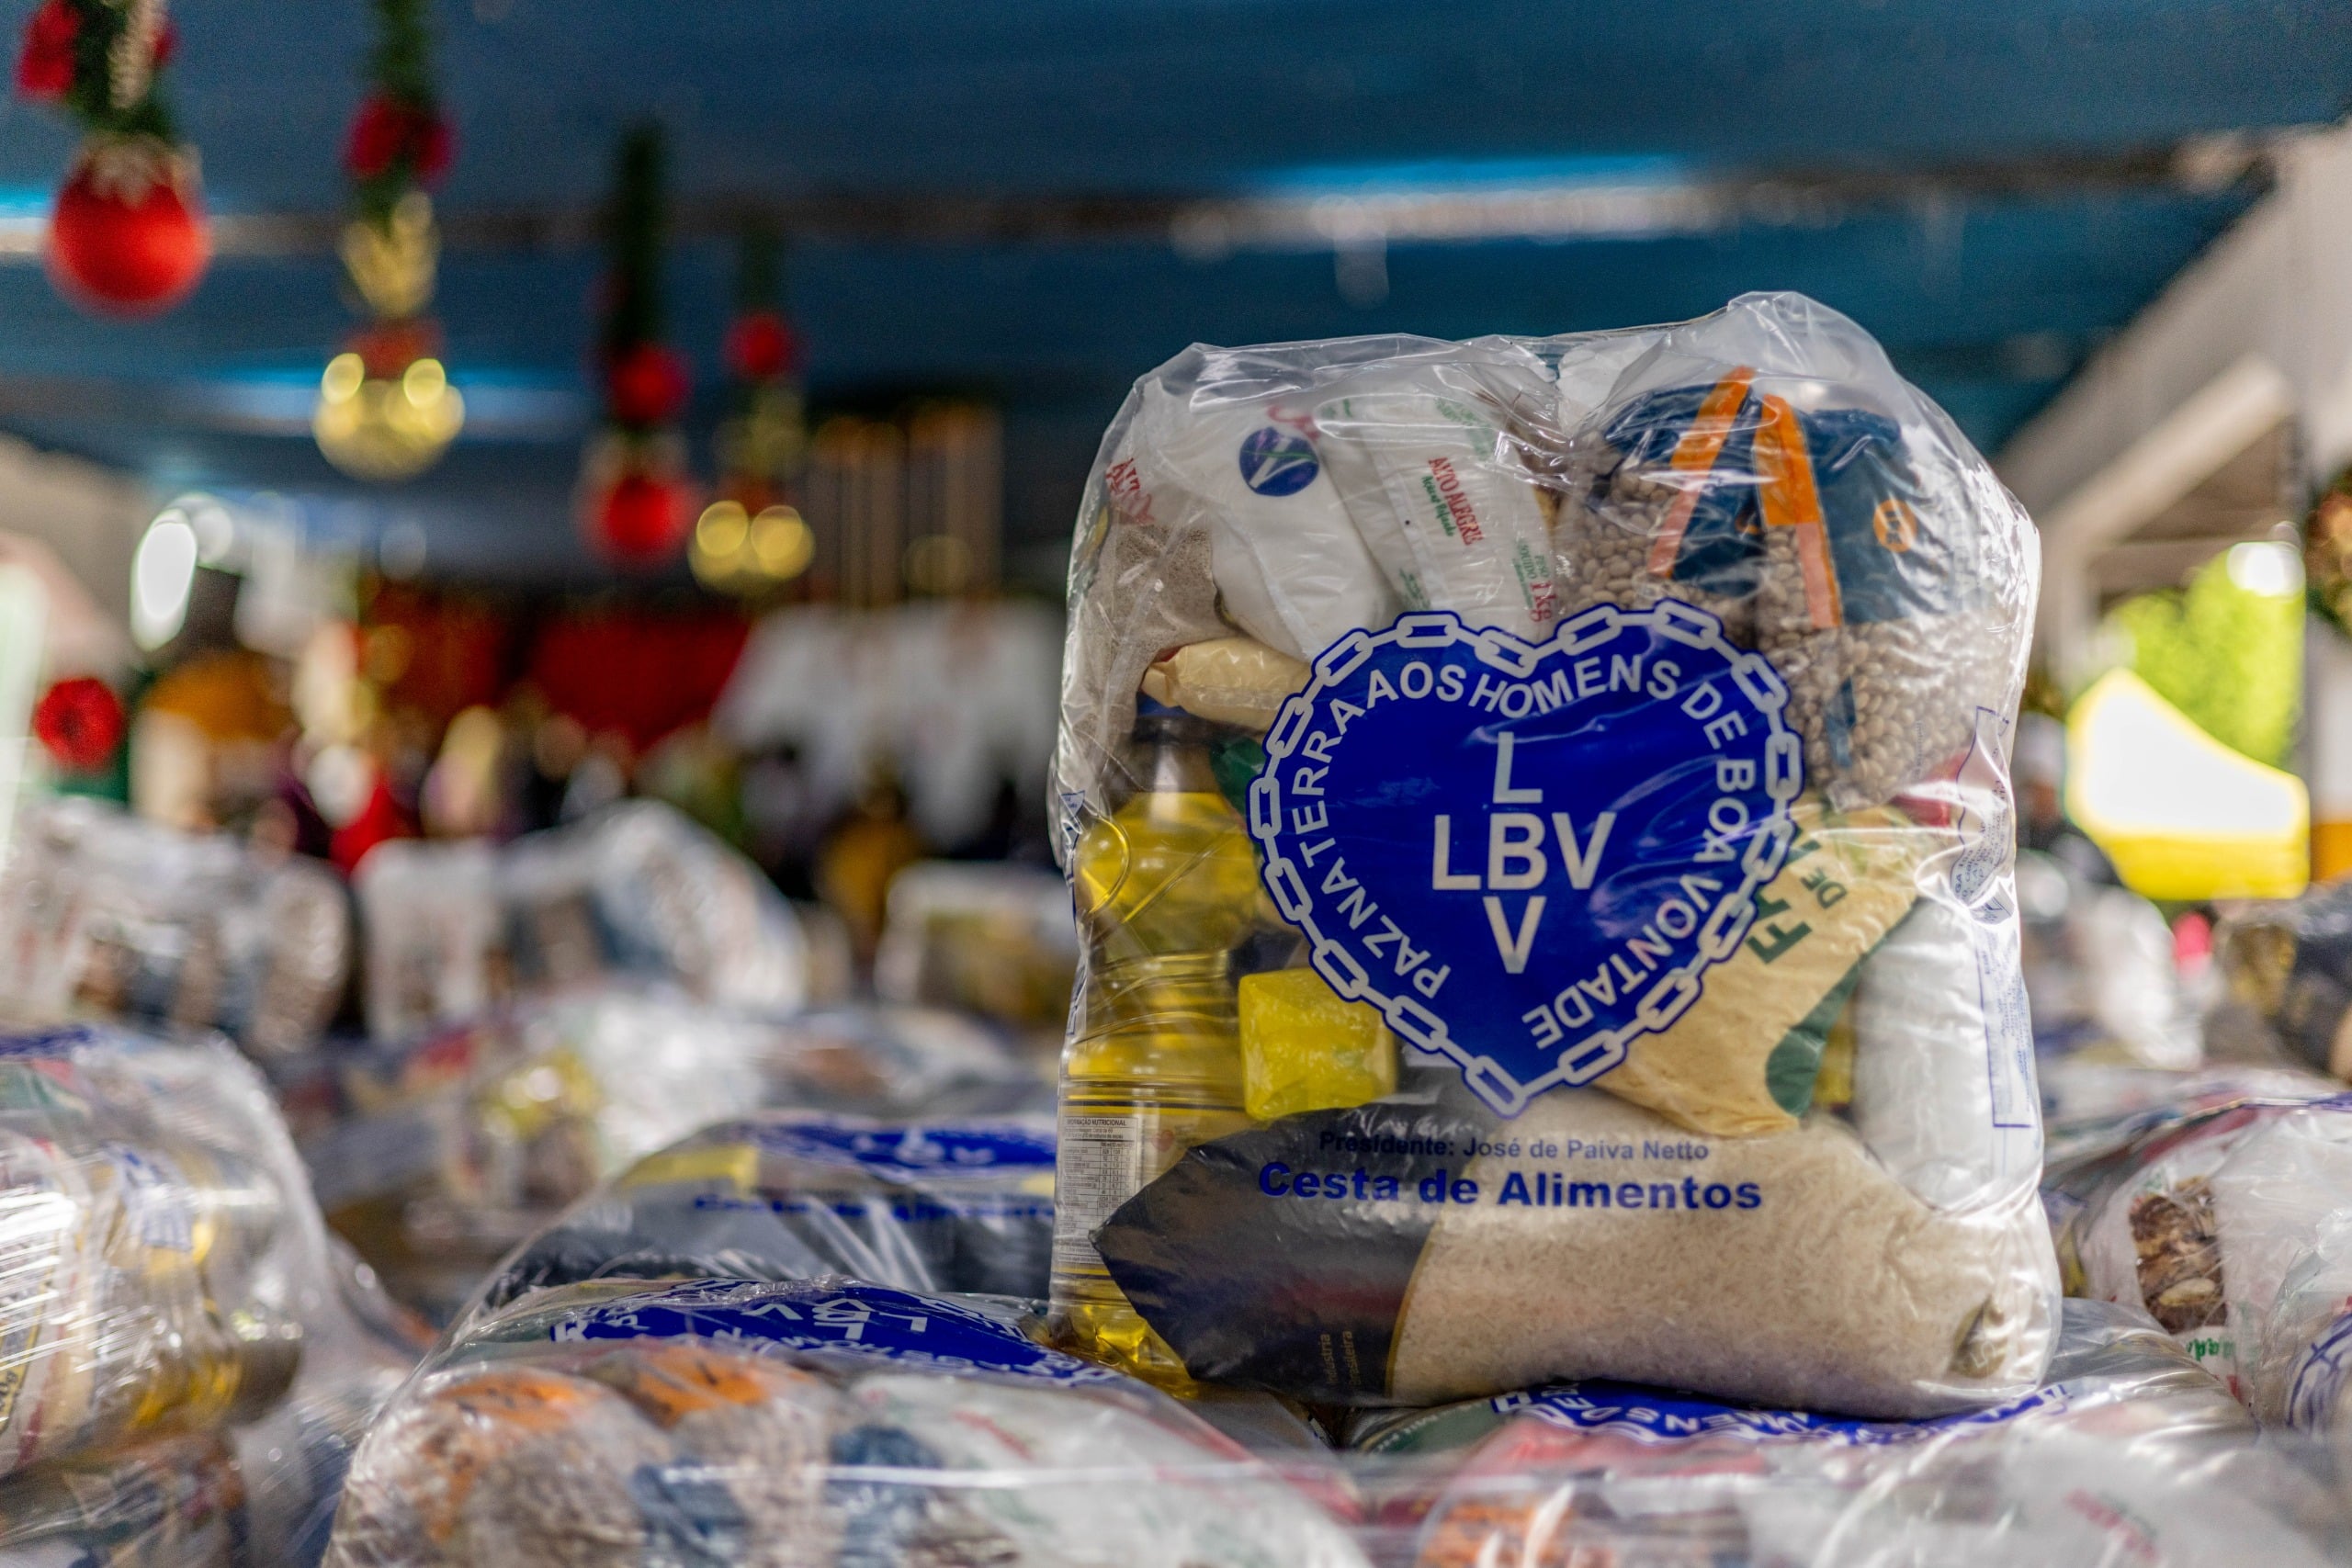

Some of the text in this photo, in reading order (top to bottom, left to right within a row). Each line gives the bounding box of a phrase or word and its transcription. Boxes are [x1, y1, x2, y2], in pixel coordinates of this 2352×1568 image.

[1443, 491, 1485, 546] ALEGRE
[1367, 660, 1467, 708] AOS
[1468, 654, 1681, 718] HOMENS
[1681, 682, 1747, 750] DE
[1293, 698, 1366, 868] TERRA
[1691, 758, 1756, 864] BOA
[1433, 812, 1616, 890] LBV
[1320, 859, 1378, 930] NA
[1362, 915, 1451, 998] PAZ
[1521, 873, 1724, 1050] VONTADE
[1092, 1118, 1126, 1126] NUTRICIONAL
[1319, 1131, 1709, 1160] Presidente: José de Paiva Netto
[1259, 1161, 1761, 1209] Cesta de Alimentos
